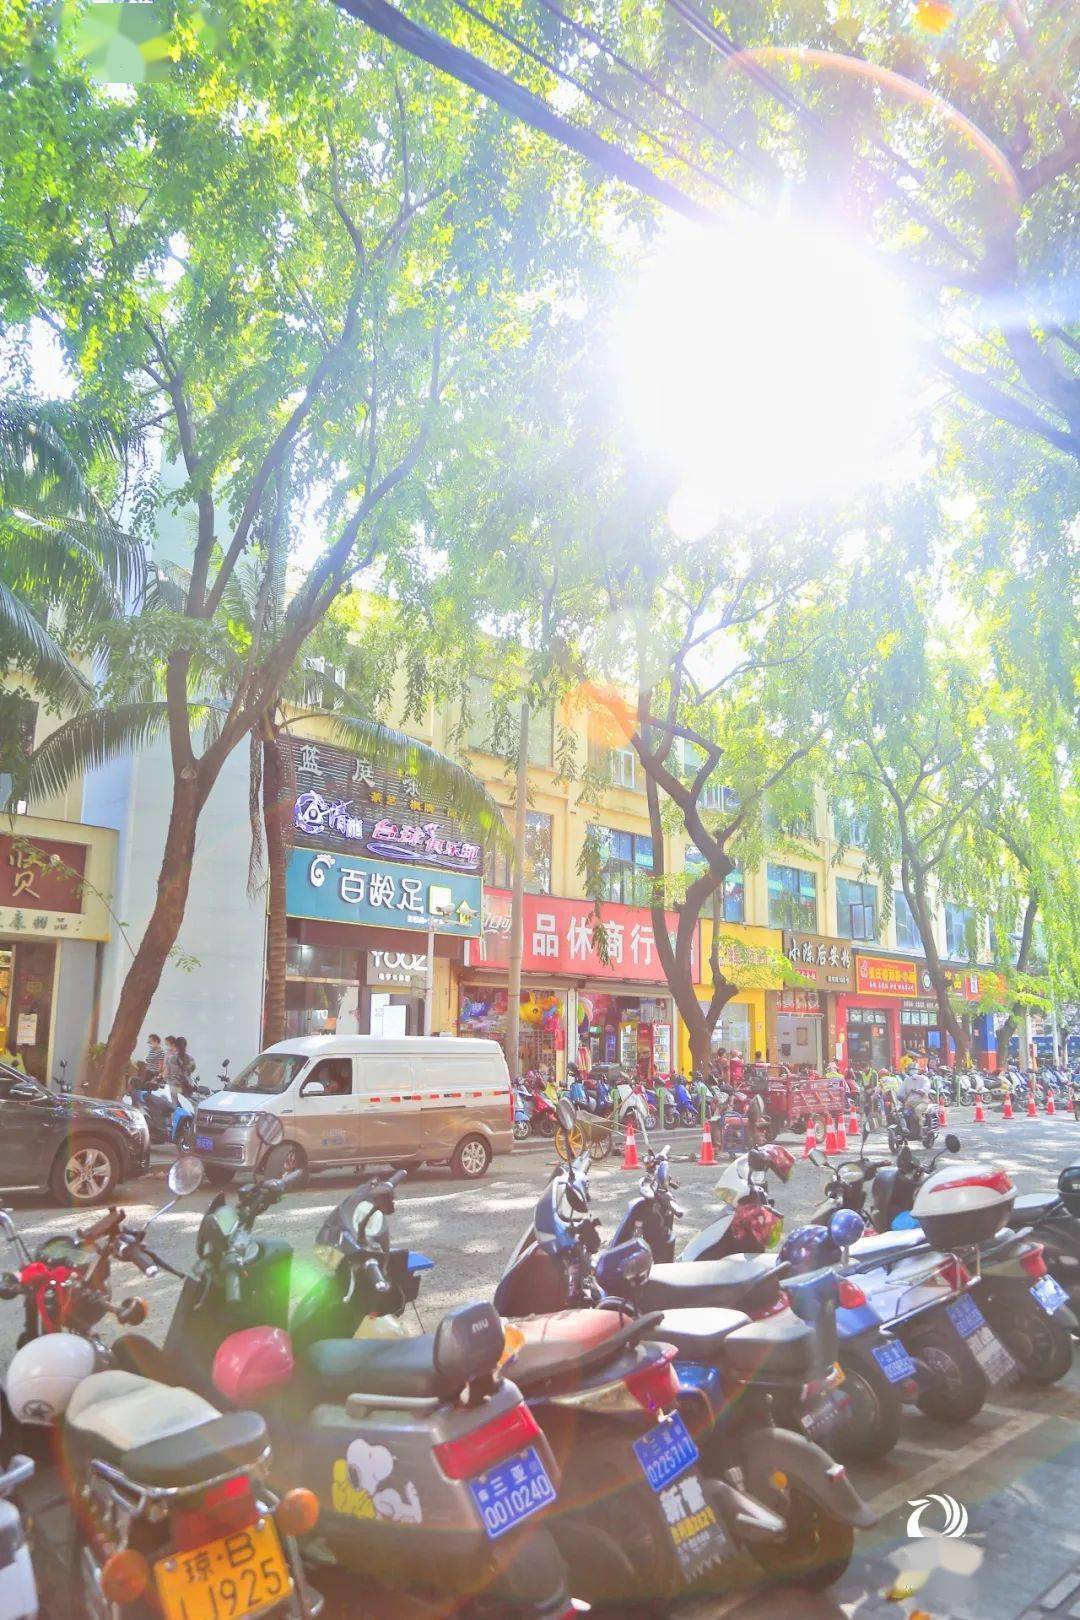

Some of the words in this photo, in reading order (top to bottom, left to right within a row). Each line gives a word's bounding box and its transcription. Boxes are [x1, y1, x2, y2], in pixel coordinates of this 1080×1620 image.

[340, 867, 425, 914] 百龄足
[371, 950, 428, 971] YOOZ
[789, 938, 852, 969] 小陈后安粉
